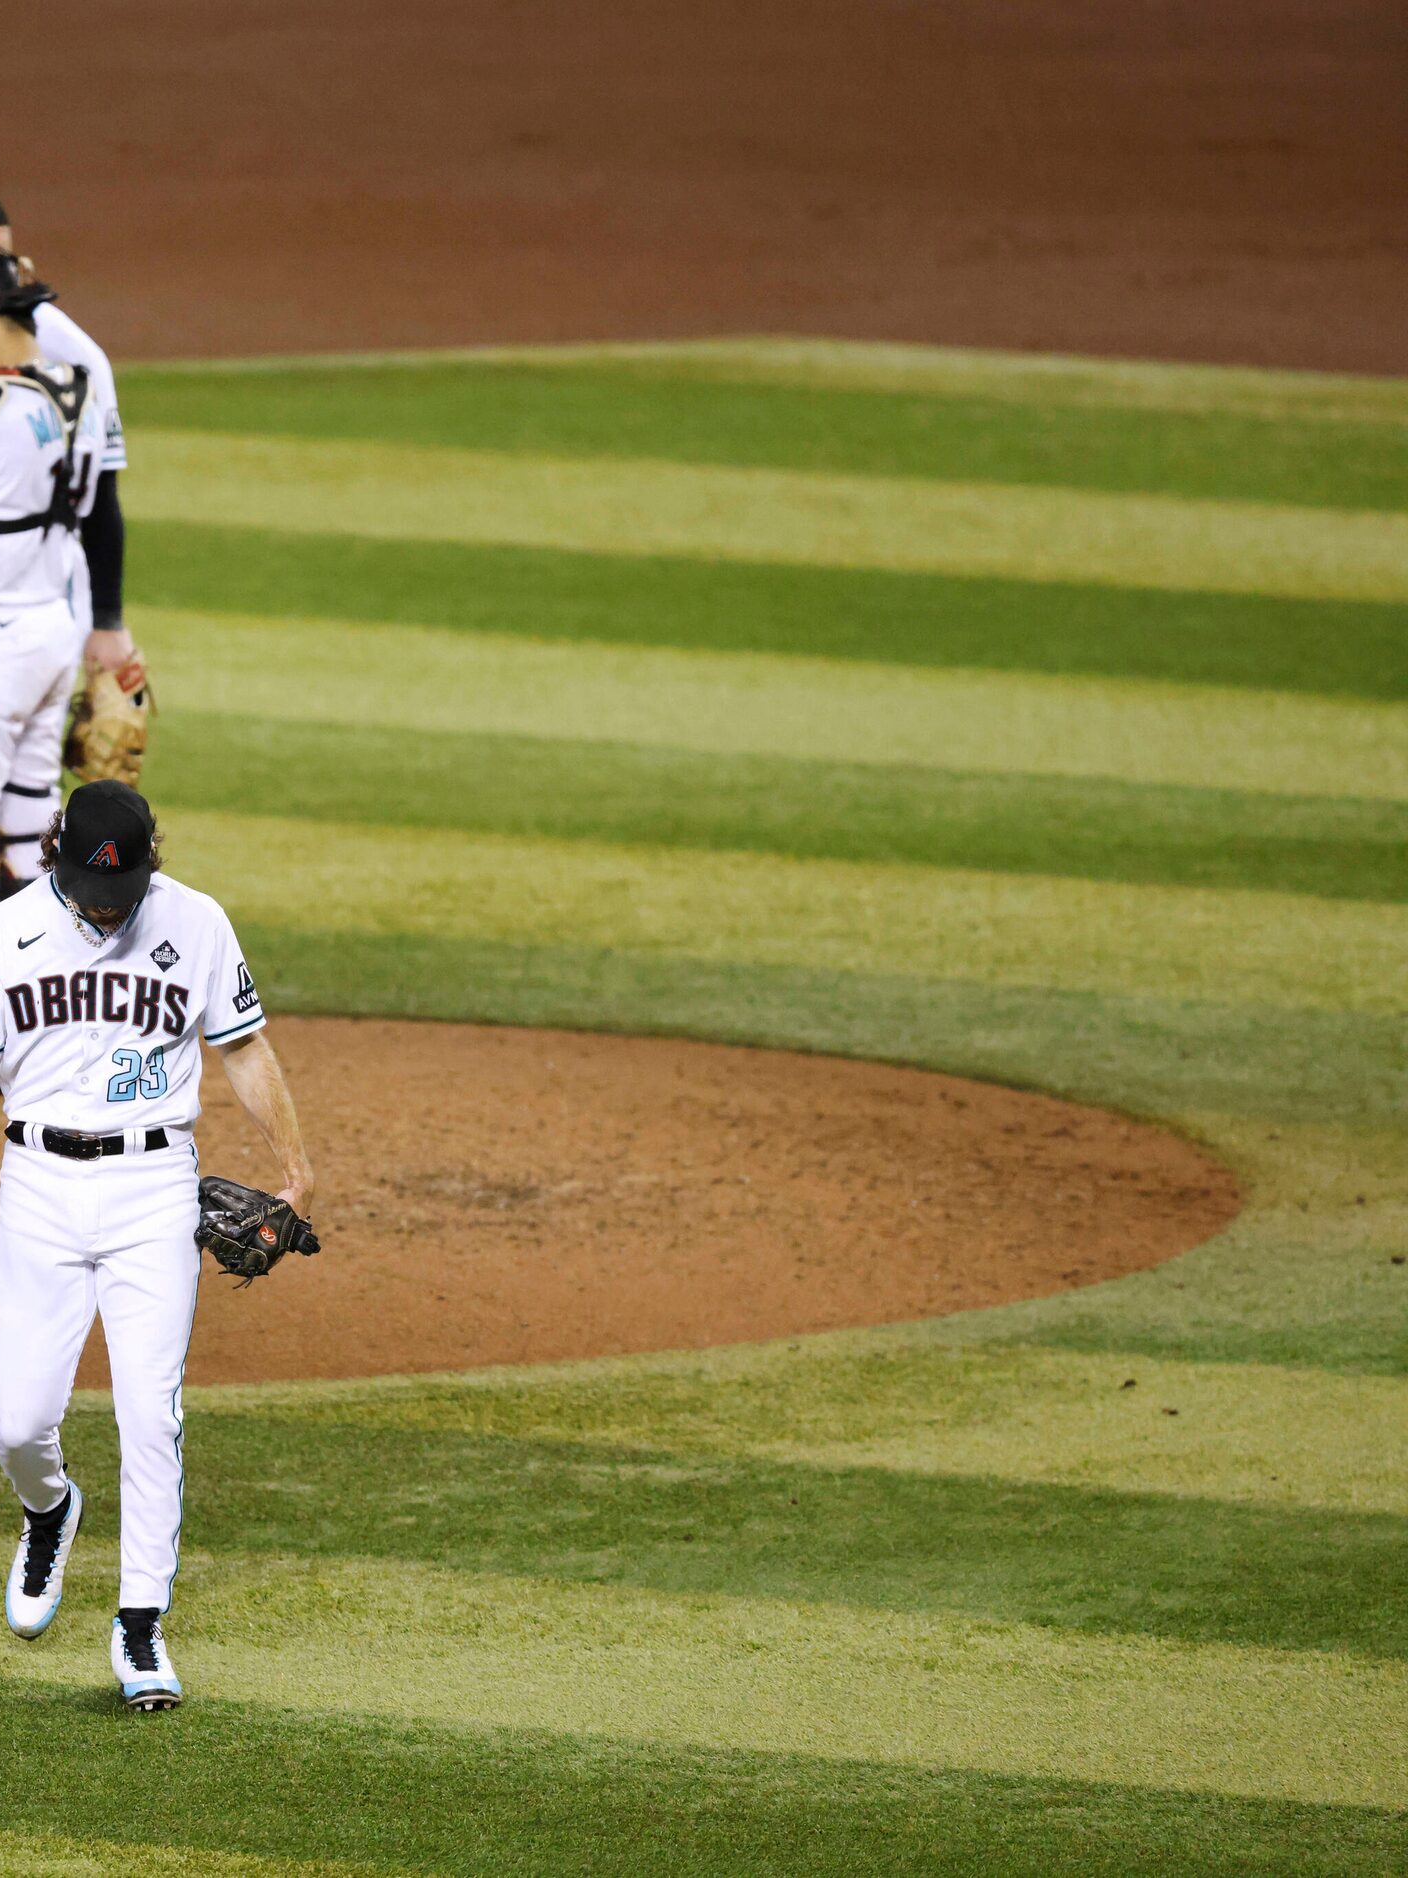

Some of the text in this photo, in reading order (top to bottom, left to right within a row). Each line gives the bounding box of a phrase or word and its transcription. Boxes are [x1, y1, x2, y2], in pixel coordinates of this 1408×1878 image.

[86, 840, 120, 867] A
[154, 950, 177, 958] WORLD
[154, 955, 177, 964] SERIES
[5, 970, 189, 1037] DBACKS
[106, 1046, 169, 1102] 23
